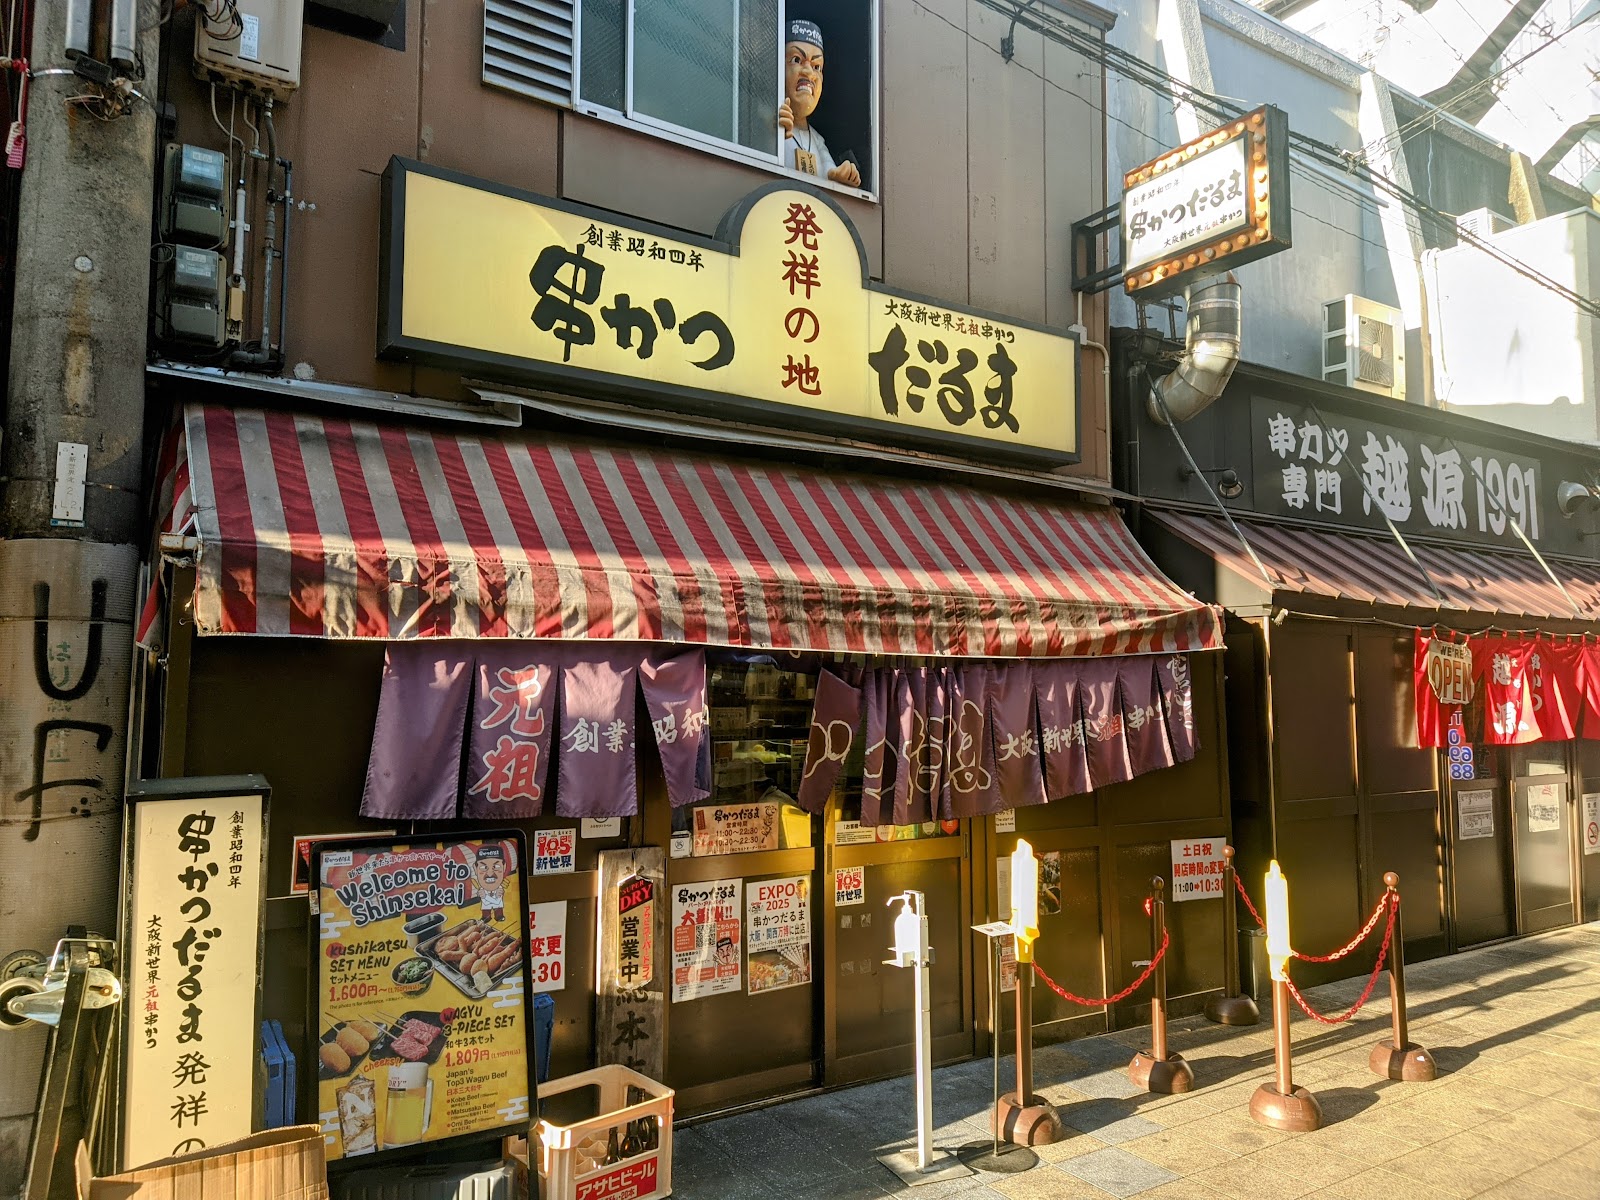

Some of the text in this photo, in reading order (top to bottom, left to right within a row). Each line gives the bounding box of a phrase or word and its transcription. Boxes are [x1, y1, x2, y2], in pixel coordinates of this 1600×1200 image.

[1130, 169, 1243, 245] 串かつだるま
[580, 223, 705, 273] 創業昭和四年
[529, 243, 735, 371] 串かつ
[781, 202, 824, 396] 発祥の地
[883, 298, 1016, 344] 大阪新世界元祖串かつ
[867, 322, 1020, 434] だるま
[1267, 412, 1349, 466] 串カツ
[1281, 462, 1342, 515] 専門
[1431, 655, 1472, 702] OPEN
[468, 664, 544, 803] 元祖
[714, 807, 760, 823] 串かつだるま
[227, 810, 244, 889] 創業昭和四年
[1183, 843, 1212, 856] 土日祝
[535, 855, 573, 871] 新世界
[1174, 860, 1225, 877] 開店時間の変更
[335, 864, 440, 907] Welcome
[443, 859, 471, 881] to
[622, 880, 645, 895] SUPER
[759, 883, 796, 901] EXPO
[350, 882, 465, 928] Shinsekai
[620, 884, 654, 911] DRY
[766, 898, 790, 911] 2025
[836, 888, 862, 903] 新世界
[753, 909, 805, 928] 串かつだるま
[531, 934, 562, 957] 変更
[620, 915, 640, 983] 営業中
[642, 905, 651, 980] アサヒスーパードライ
[329, 956, 391, 973] SET MENU
[143, 914, 162, 1050] 大阪新世界元祖串かつ
[329, 973, 380, 985] セットメニュー
[443, 1004, 483, 1022] WAGYU
[444, 1014, 516, 1037] 3-PIECE SET
[446, 1033, 495, 1049] 和牛3本セット
[446, 1068, 474, 1079] Japan's
[466, 1074, 490, 1084] Wagyu
[491, 1071, 508, 1079] Beef
[466, 1093, 480, 1101] Beef
[450, 1106, 482, 1116] Matsusaka
[482, 1102, 496, 1110] Beef
[578, 1162, 656, 1200] アサヒビール
